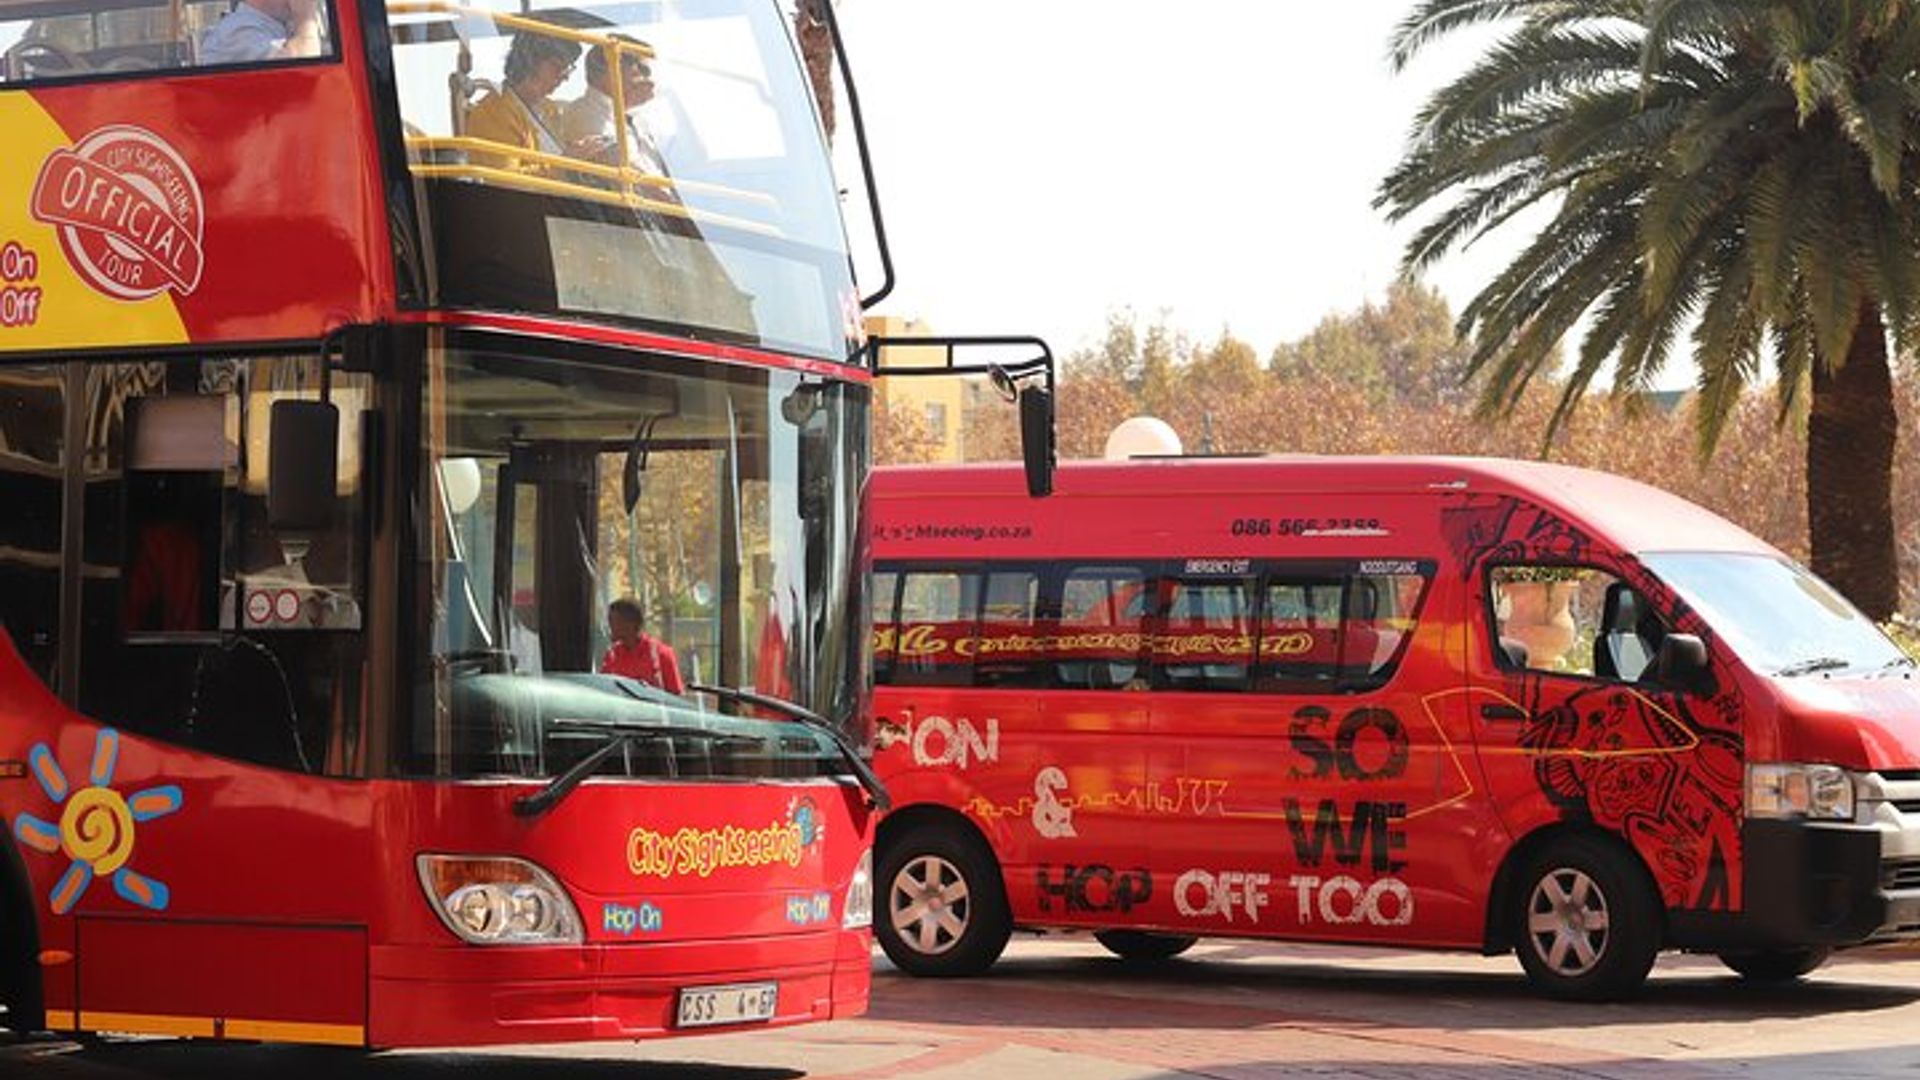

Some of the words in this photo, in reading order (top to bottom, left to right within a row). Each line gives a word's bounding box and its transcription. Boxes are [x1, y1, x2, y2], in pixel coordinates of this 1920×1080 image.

[61, 165, 187, 271] OFFICIAL
[1, 242, 36, 280] On
[97, 249, 144, 285] TOUR
[0, 289, 40, 324] Off
[1231, 518, 1271, 536] 086
[911, 715, 999, 770] ON
[1287, 704, 1410, 781] SO
[1032, 766, 1079, 838] &
[1282, 797, 1409, 876] WE
[1036, 863, 1153, 915] HOP
[1173, 869, 1271, 924] OFF
[1288, 874, 1415, 926] TOO
[603, 902, 636, 935] Hop
[639, 901, 662, 931] On
[681, 994, 716, 1021] CSS
